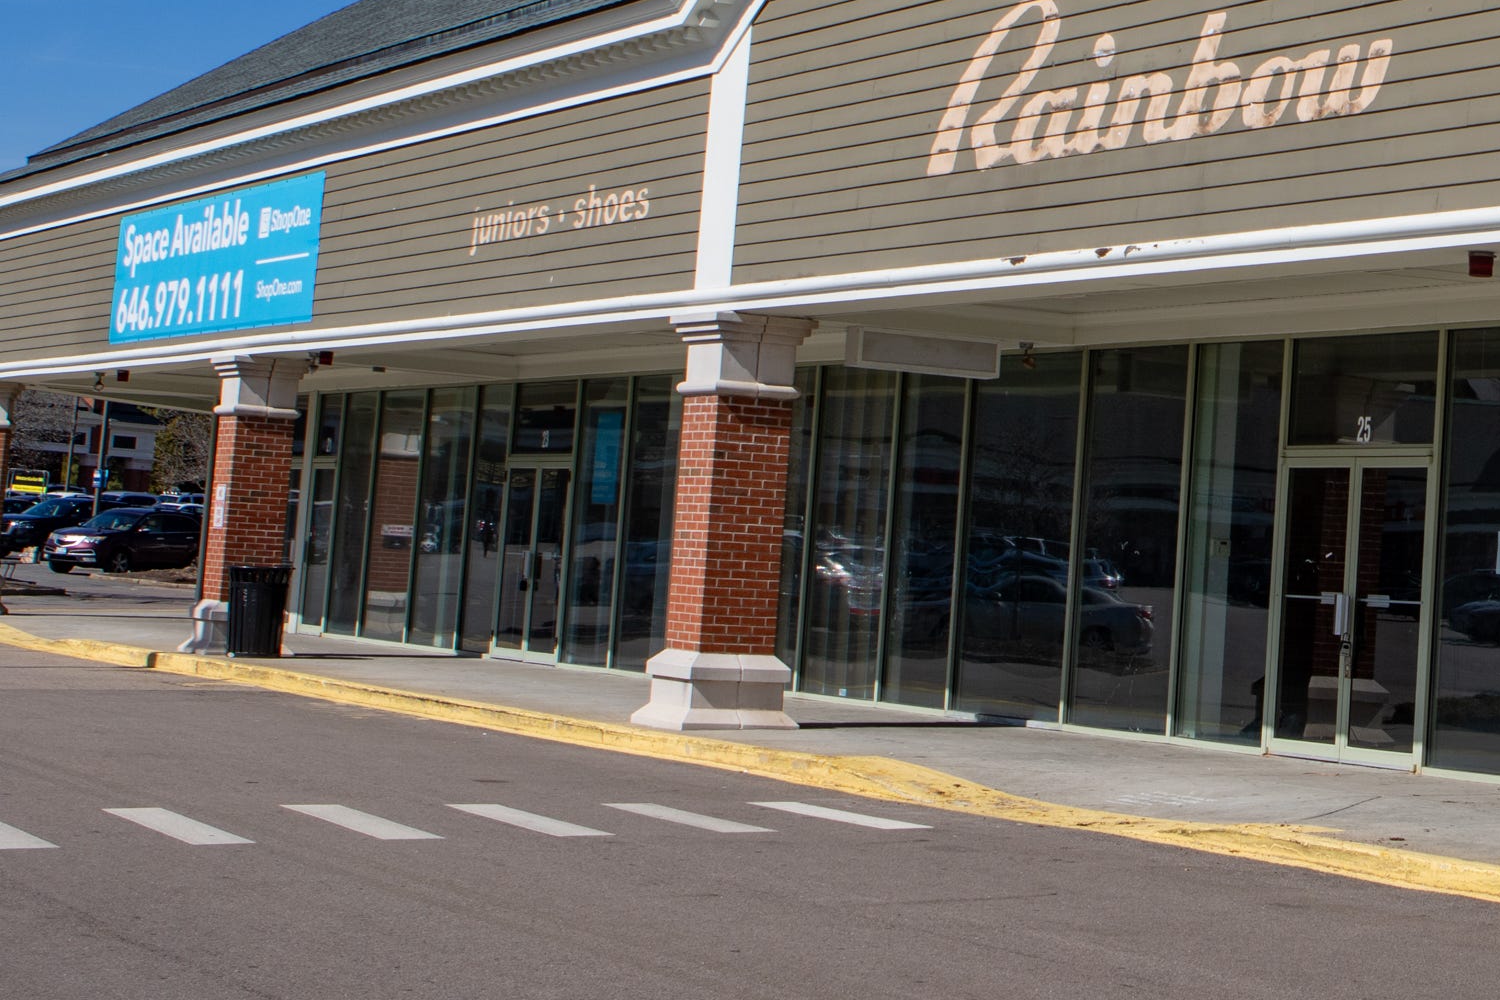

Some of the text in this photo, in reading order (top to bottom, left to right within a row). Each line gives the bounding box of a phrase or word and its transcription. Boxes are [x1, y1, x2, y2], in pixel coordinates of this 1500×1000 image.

[123, 199, 249, 278] Space Available
[271, 205, 311, 233] ShopOne
[469, 184, 650, 257] juniors shoes
[116, 269, 244, 333] 646.979.1111
[256, 278, 302, 302] ShopOne.com
[1357, 416, 1371, 442] 25
